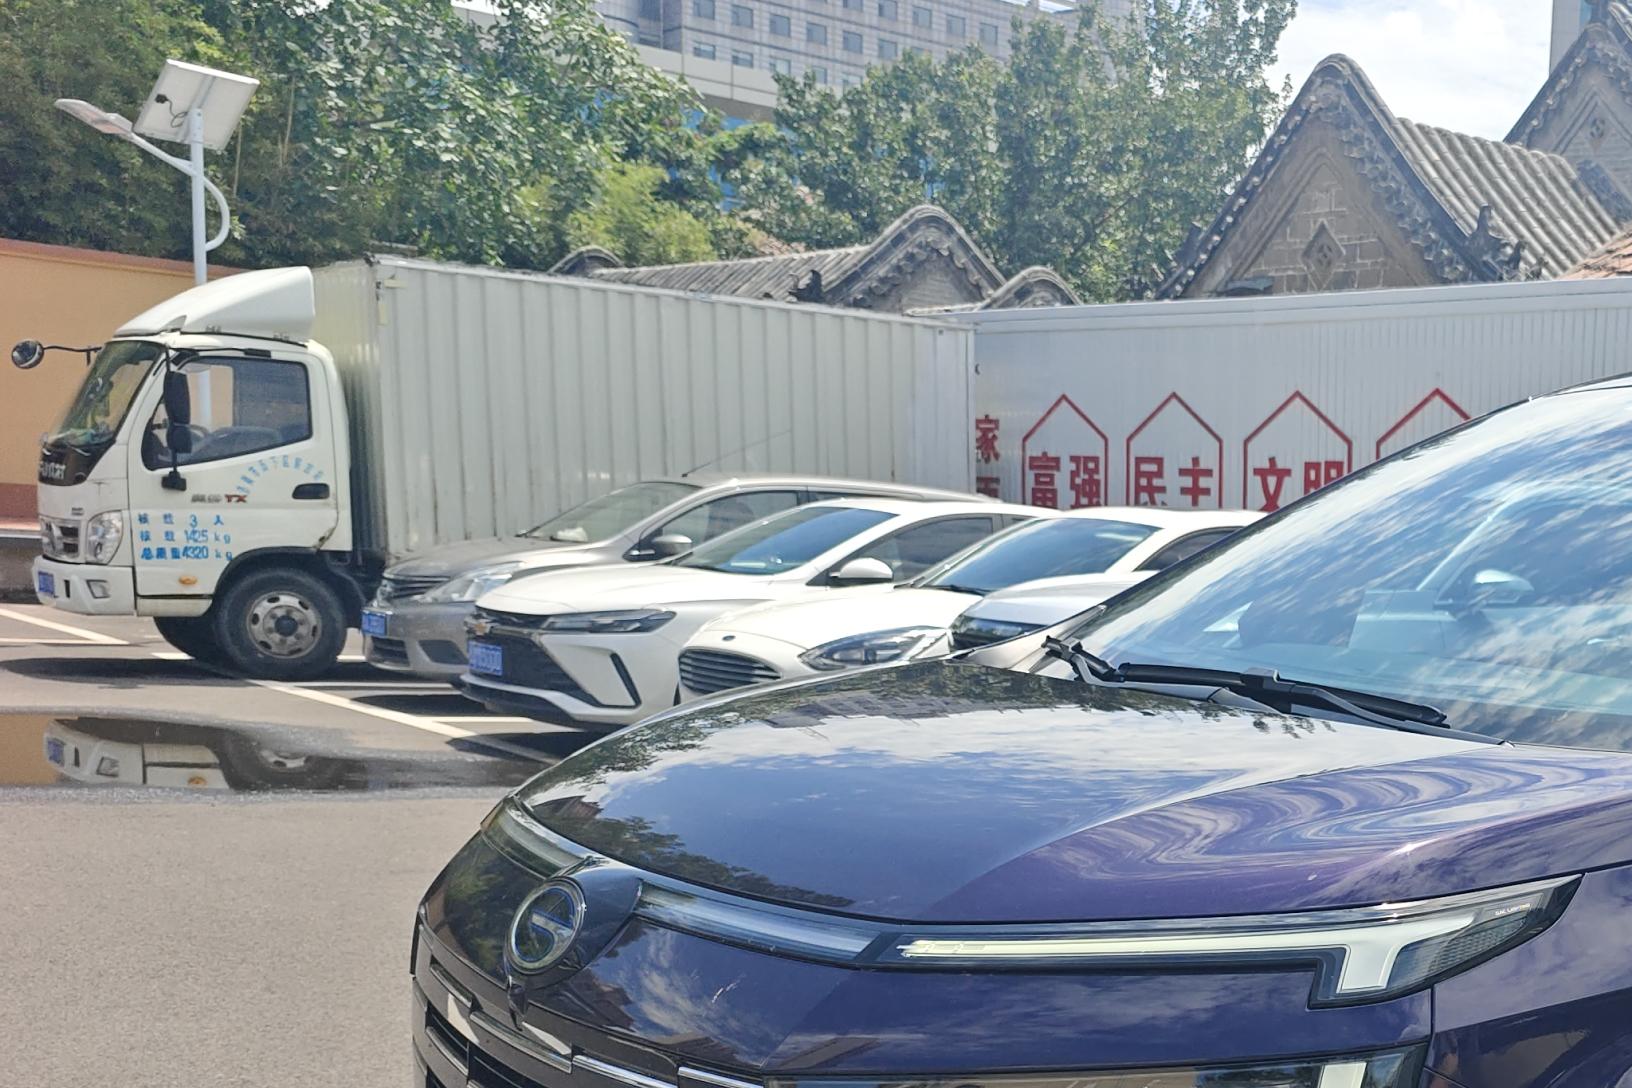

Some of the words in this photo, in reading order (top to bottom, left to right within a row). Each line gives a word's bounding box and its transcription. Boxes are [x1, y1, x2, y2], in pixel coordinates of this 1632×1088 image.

[1028, 451, 1103, 510] 富强
[1134, 456, 1213, 507] 民主
[1252, 456, 1345, 512] 文明
